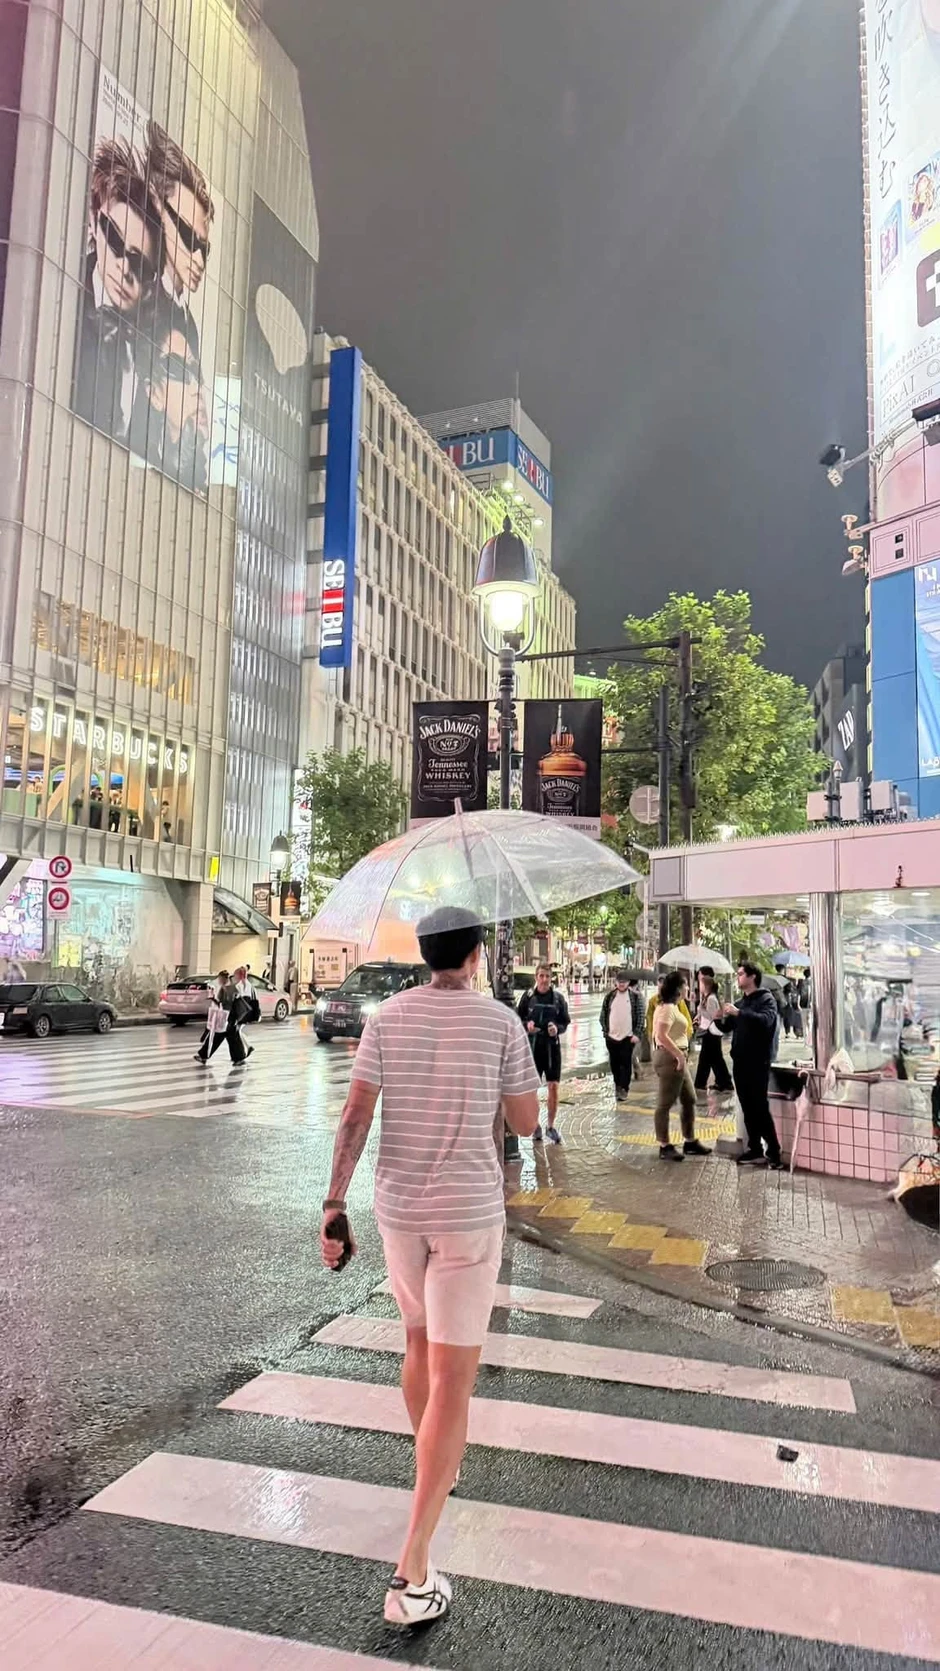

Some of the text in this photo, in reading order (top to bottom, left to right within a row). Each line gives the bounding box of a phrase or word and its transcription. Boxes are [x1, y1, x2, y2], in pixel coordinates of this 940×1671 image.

[254, 372, 303, 428] TSUTAYA
[518, 444, 549, 499] SEIBU
[321, 559, 346, 650] SEIBU
[30, 706, 189, 774] STARBUCKS
[419, 719, 481, 740] JACK DANIEL'S
[428, 758, 468, 768] Tennessee
[541, 780, 556, 792] JACK
